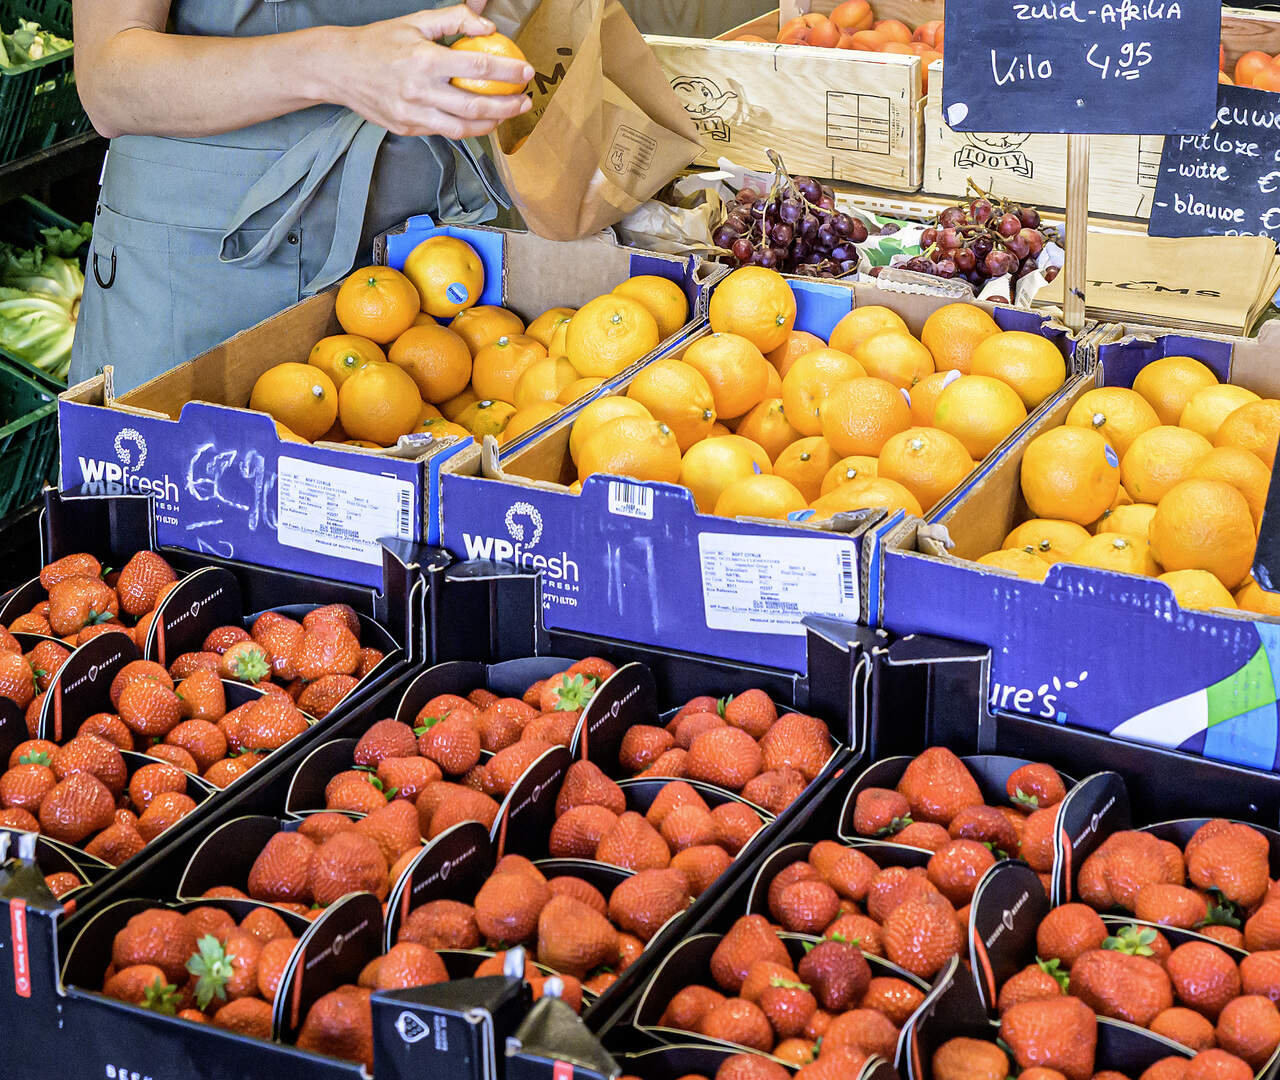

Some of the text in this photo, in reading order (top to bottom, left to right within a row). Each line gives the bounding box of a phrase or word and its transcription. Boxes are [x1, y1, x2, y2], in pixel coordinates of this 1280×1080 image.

[965, 148, 1022, 168] TOOTY
[1174, 193, 1245, 223] blauwe
[560, 596, 577, 607] (LTD)
